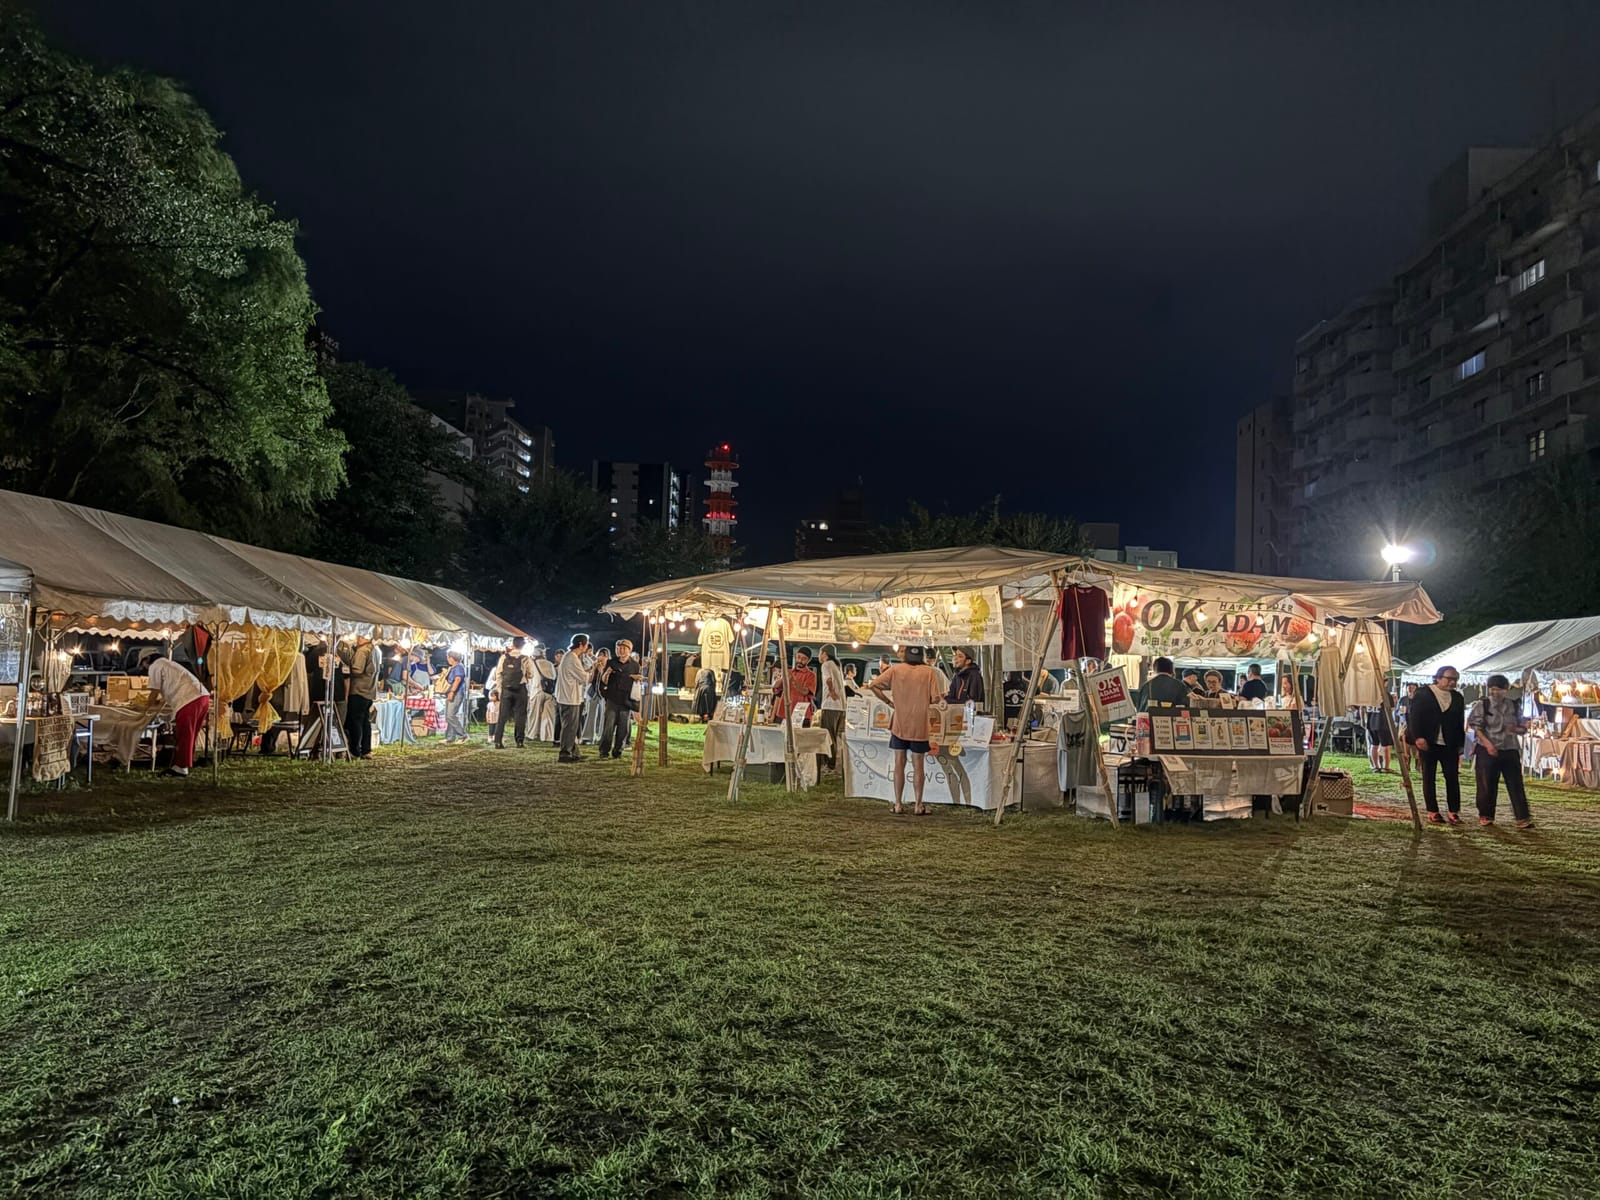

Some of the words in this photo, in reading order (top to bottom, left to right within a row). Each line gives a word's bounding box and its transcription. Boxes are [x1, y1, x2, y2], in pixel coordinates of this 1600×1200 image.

[876, 607, 950, 627] brewery
[1141, 599, 1209, 635] OK,
[1211, 614, 1293, 635] ADAM
[887, 763, 963, 791] bewery
